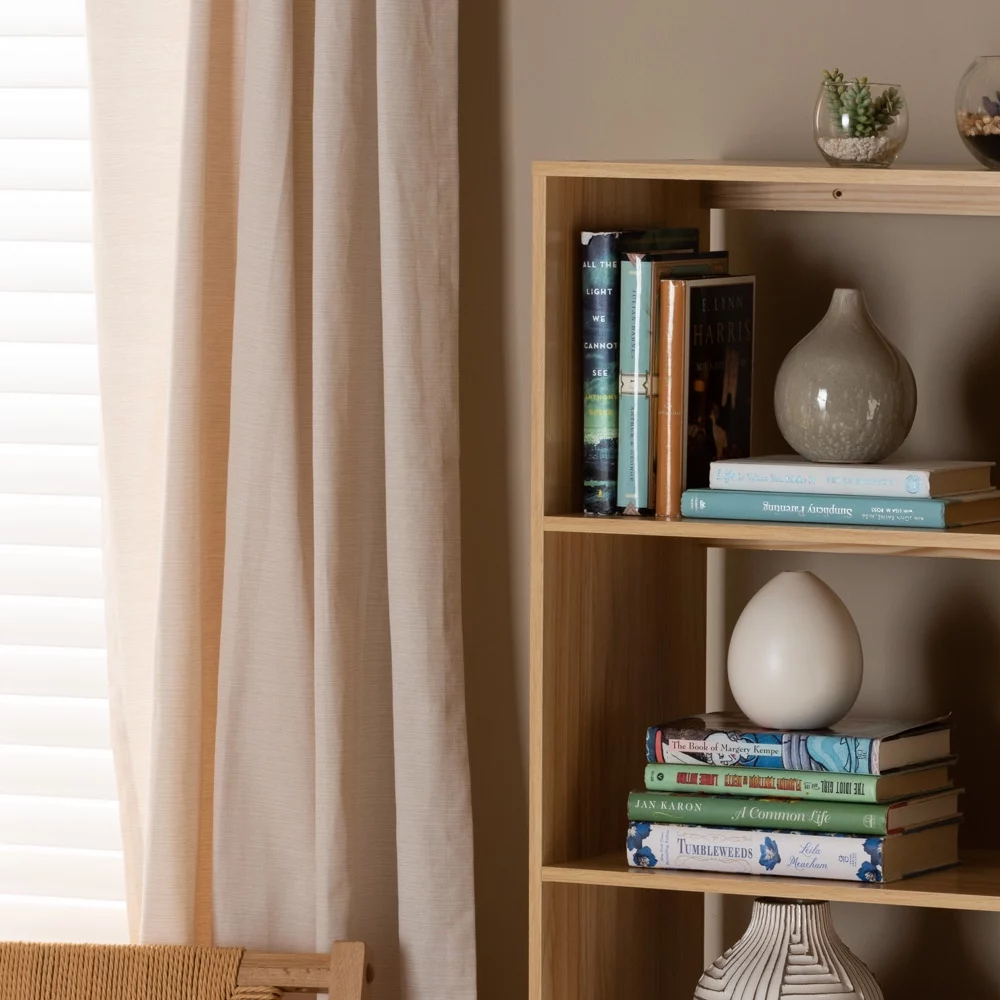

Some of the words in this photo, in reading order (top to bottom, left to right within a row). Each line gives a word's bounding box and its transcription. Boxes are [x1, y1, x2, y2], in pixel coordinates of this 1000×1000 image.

[712, 294, 743, 311] LYNN
[693, 318, 751, 346] HARRIS
[584, 342, 618, 350] CANNOT
[592, 369, 608, 377] SEE
[763, 501, 806, 516] Parenting
[807, 503, 853, 518] Simplicity
[672, 740, 686, 750] The
[689, 741, 709, 751] Book
[710, 741, 719, 751] of
[720, 744, 750, 755] Margery
[753, 745, 779, 755] Kempe
[821, 780, 834, 794] GIRL
[835, 781, 852, 795] IDIOT
[853, 782, 865, 796] THE
[634, 799, 656, 809] JAN
[660, 801, 702, 812] KARON
[731, 806, 746, 820] A
[749, 806, 805, 822] Common
[808, 809, 832, 827] Life
[677, 838, 753, 859] TUMBLEWEEDS
[799, 841, 822, 855] Leila
[787, 855, 828, 870] Meacham
